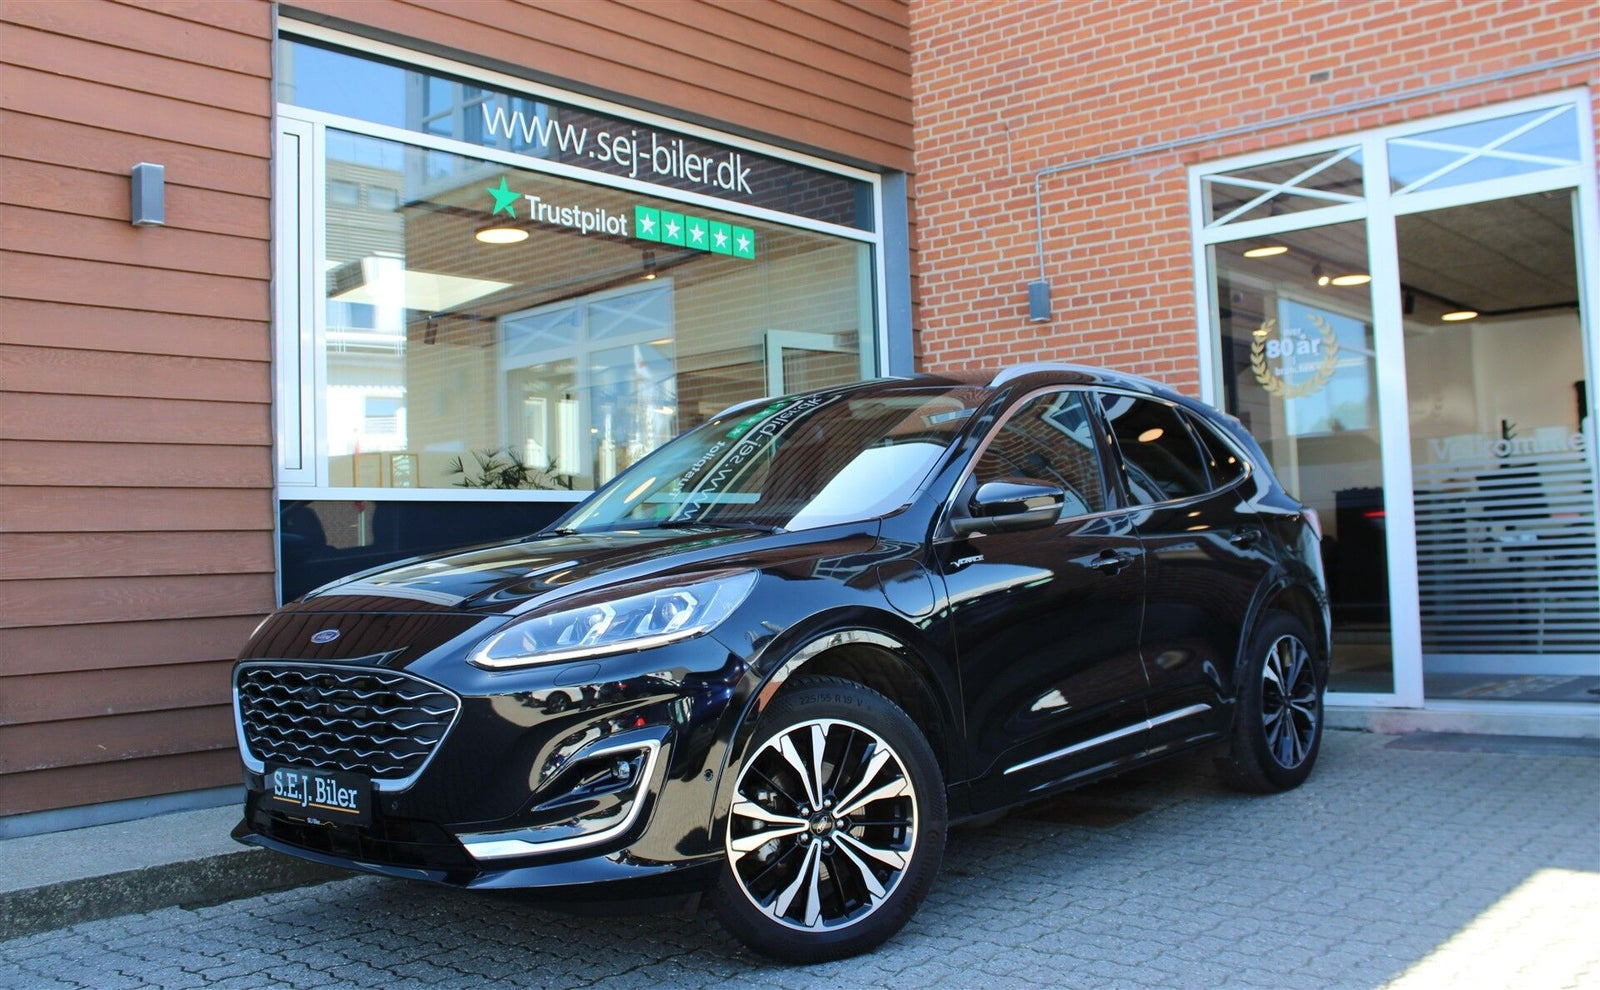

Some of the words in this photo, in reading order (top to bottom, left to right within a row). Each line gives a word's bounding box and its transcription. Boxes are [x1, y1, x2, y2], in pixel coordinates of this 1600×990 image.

[481, 103, 753, 194] www.sej-biler.dk
[524, 194, 628, 236] Trustpilot
[1265, 339, 1294, 358] 80
[1296, 333, 1320, 355] år
[274, 770, 312, 807] S.E.J.
[315, 777, 357, 808] Biler
